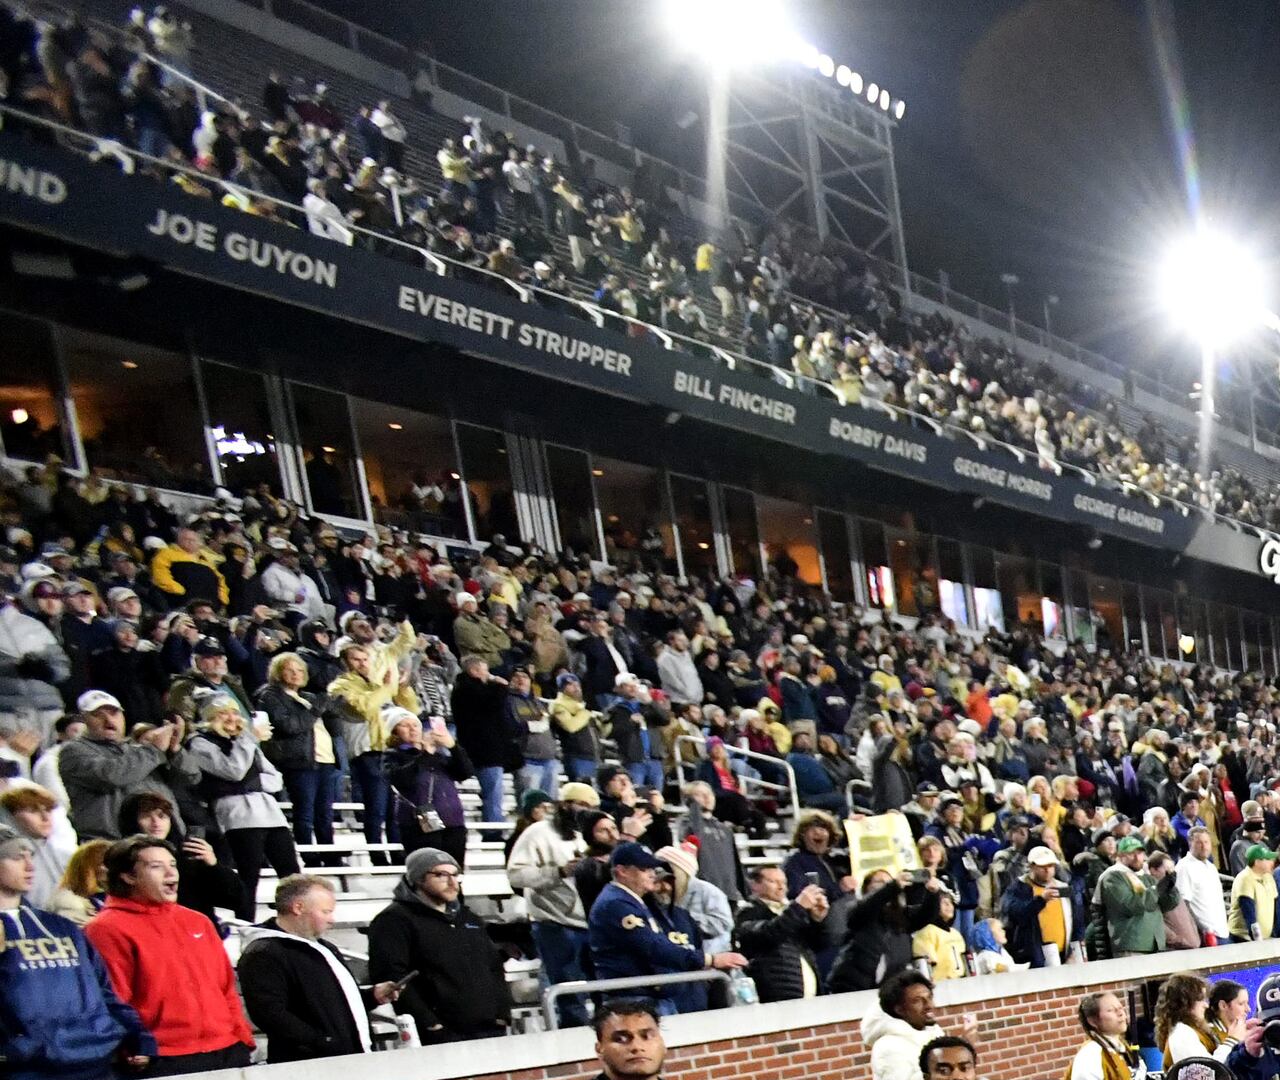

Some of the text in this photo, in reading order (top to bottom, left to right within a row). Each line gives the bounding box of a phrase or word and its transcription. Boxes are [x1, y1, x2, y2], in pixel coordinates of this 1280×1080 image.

[0, 159, 68, 204] ND
[147, 208, 337, 288] JOE GUYON
[400, 286, 632, 376] EVERETT STRUPPER
[674, 370, 795, 425] BILL FINCHER
[829, 417, 927, 464] BOBBY DAVIS
[954, 456, 1006, 486] GEORGE
[5, 936, 79, 961] ECH
